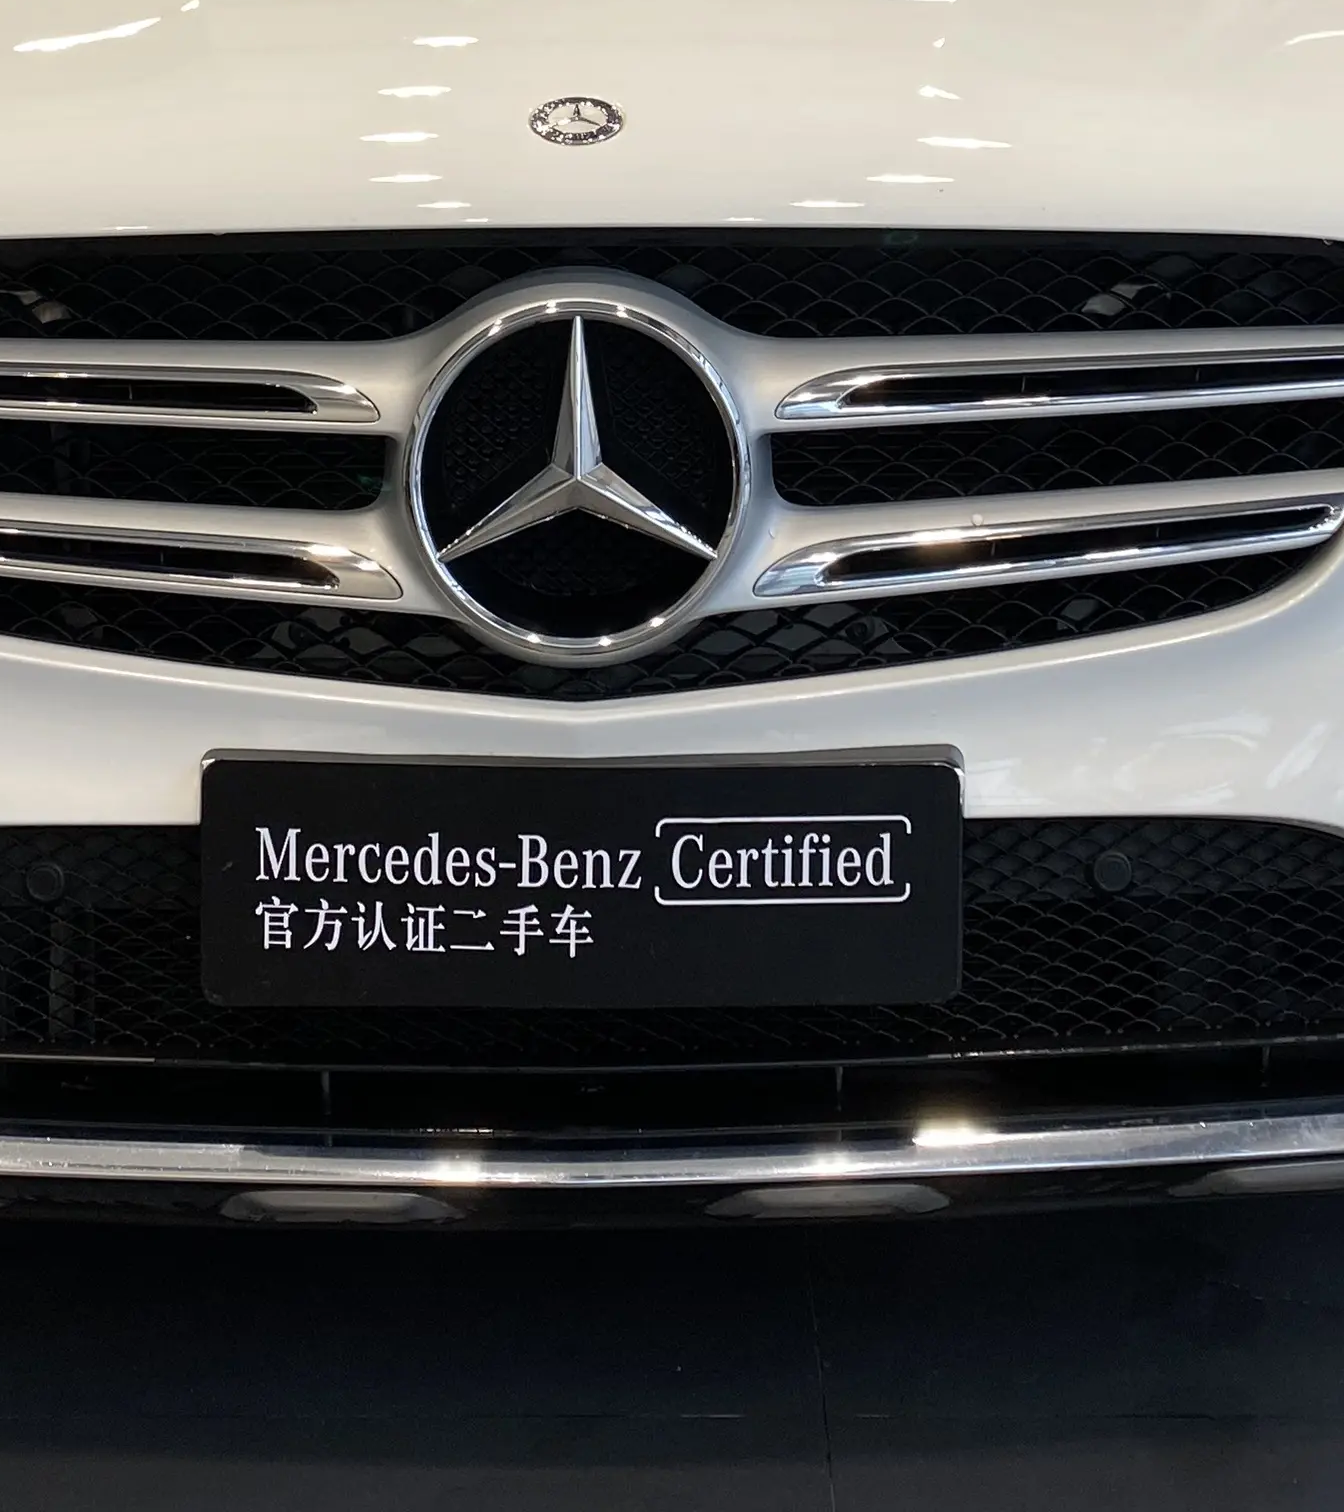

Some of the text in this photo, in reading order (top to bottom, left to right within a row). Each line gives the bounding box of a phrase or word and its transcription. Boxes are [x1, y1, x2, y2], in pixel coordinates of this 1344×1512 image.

[256, 826, 895, 890] Mercedes-Benz Certified
[256, 896, 594, 958] 官方认证二手车
